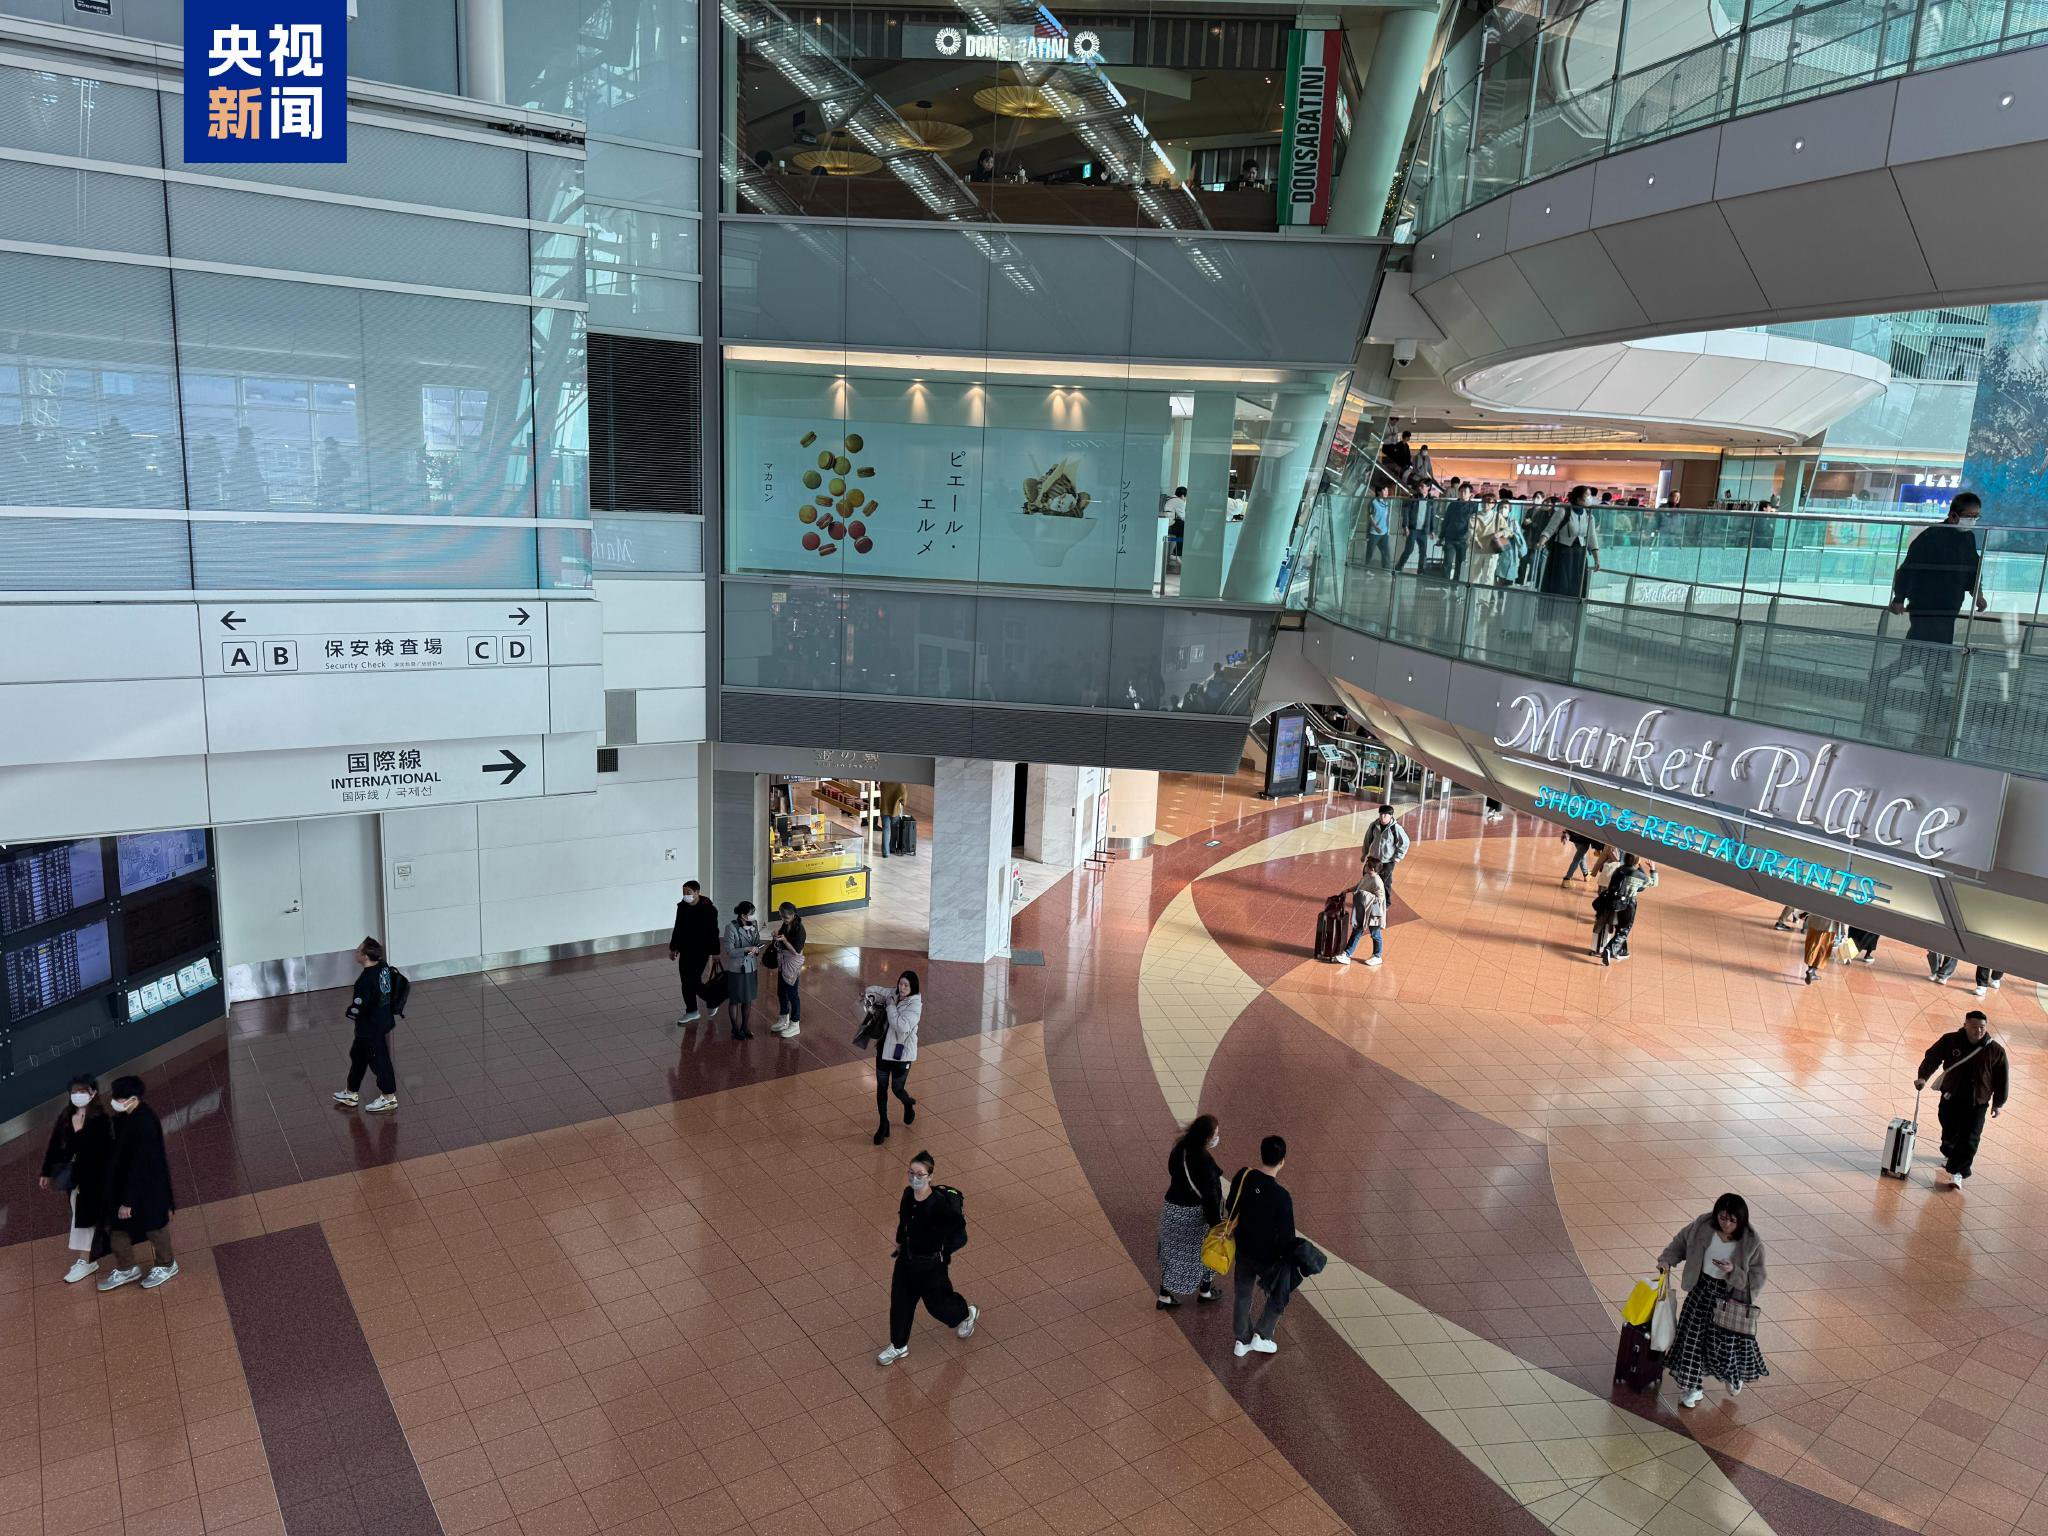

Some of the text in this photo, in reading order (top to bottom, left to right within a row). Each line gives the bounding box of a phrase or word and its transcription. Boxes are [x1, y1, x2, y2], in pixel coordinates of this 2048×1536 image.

[965, 35, 1069, 59] DONSBATINI
[1290, 65, 1326, 204] DONSABATINI
[763, 462, 775, 503] マカロン
[1516, 463, 1556, 476] PLAZA
[1914, 473, 1960, 488] PLAZ
[916, 497, 936, 556] エルメ
[1118, 480, 1131, 554] ソフトクリーム
[230, 637, 526, 667] A B 保安検査場 C D
[325, 662, 359, 670] Security
[361, 661, 386, 669] Check
[347, 748, 422, 774] 国際線
[331, 771, 442, 790] INTERNATIONAL
[1493, 695, 1950, 860] Market Place
[342, 788, 380, 802] 国际线
[394, 784, 433, 798] 국제선
[1534, 784, 1876, 905] SHOPS & RESTAURANTS
